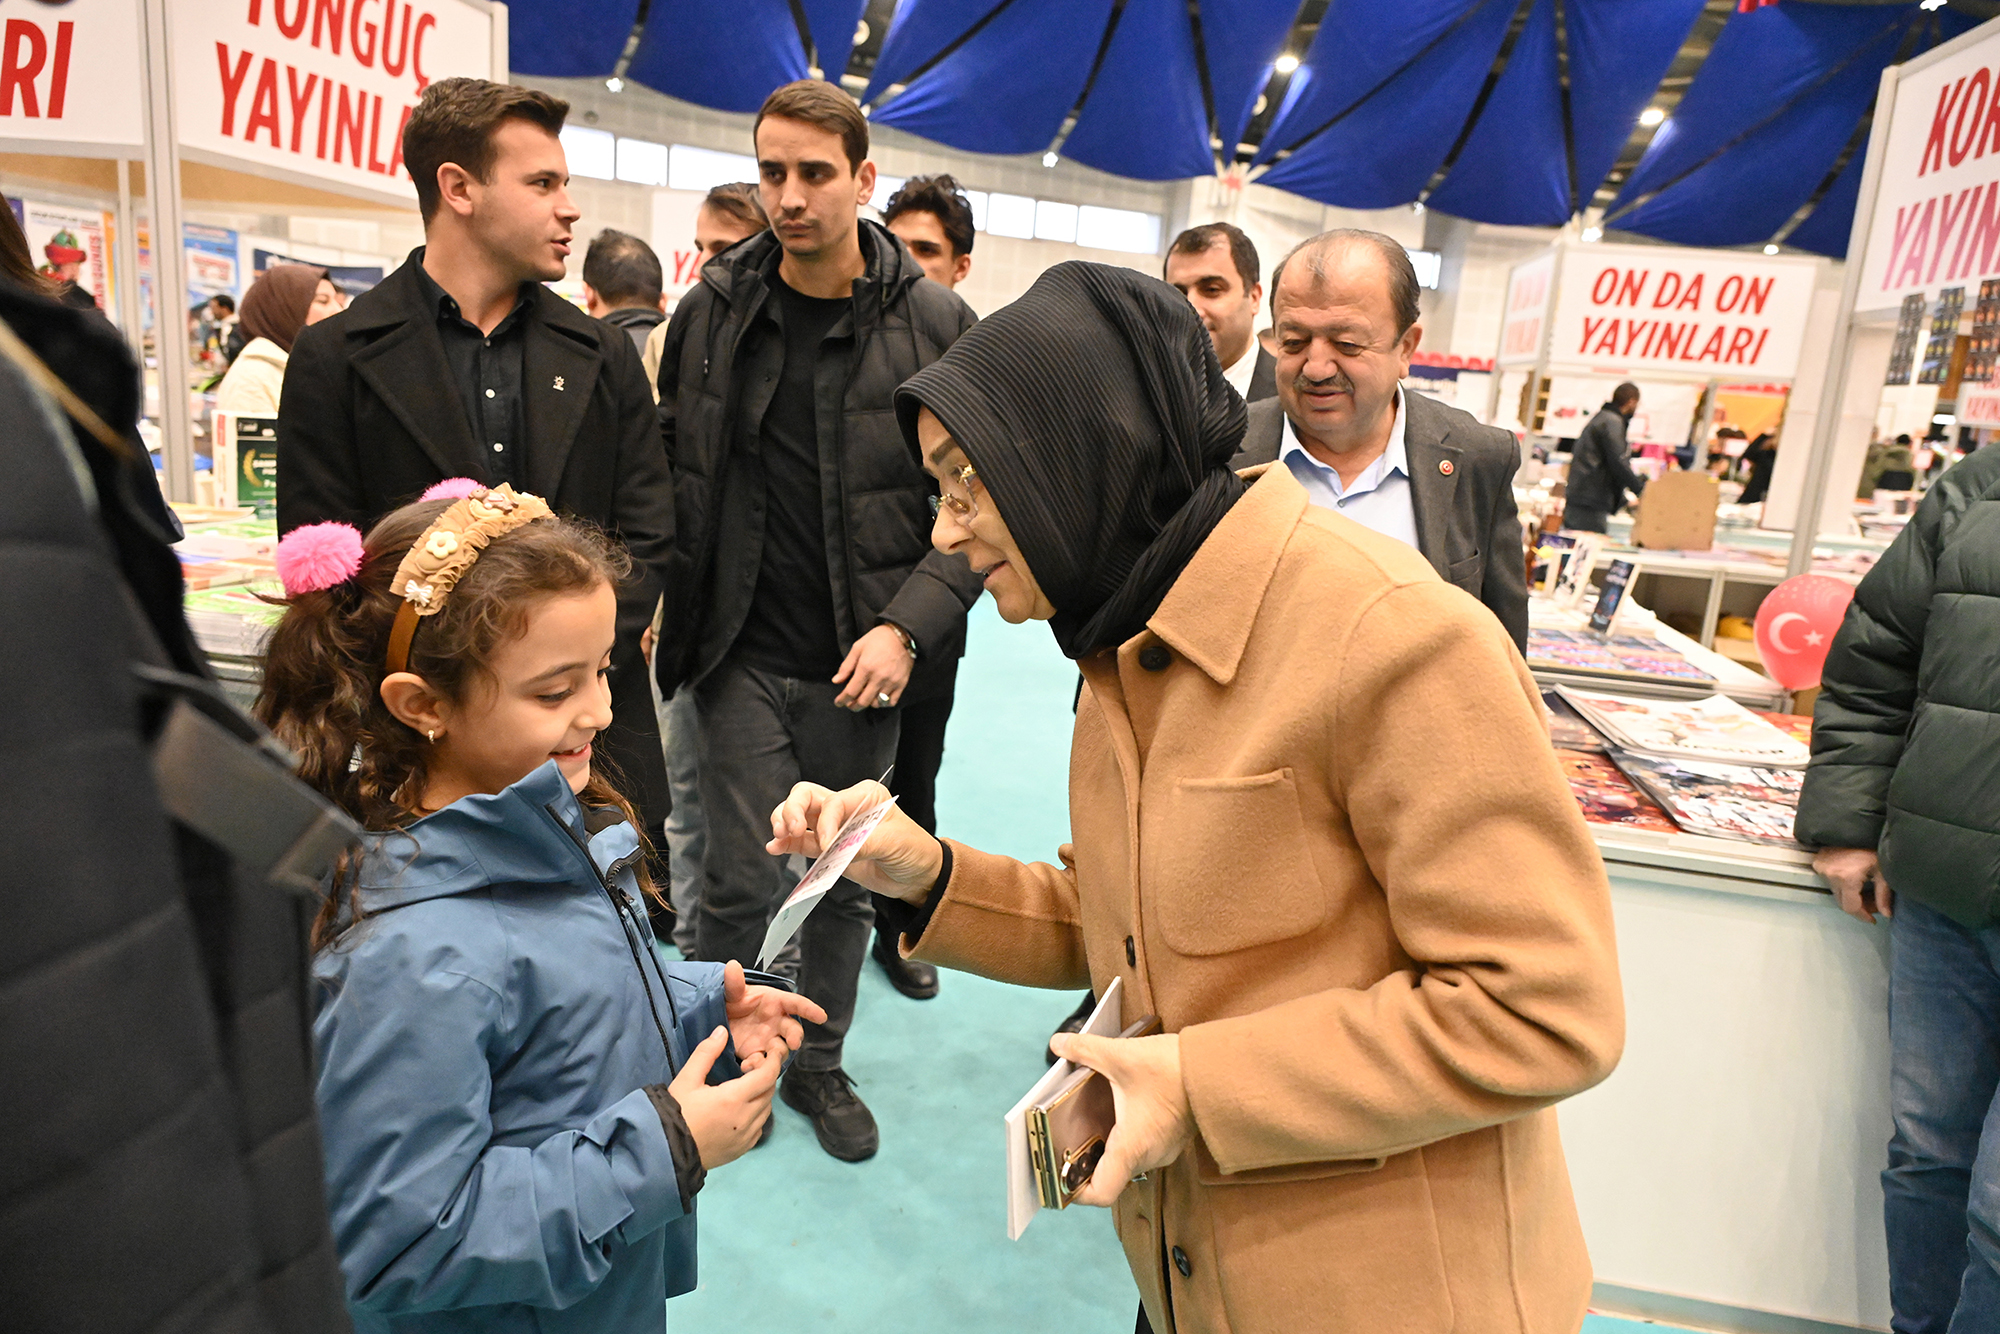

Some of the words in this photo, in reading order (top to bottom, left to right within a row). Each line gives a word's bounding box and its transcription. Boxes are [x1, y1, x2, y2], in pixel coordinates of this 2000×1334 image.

[248, 0, 434, 97] NGUÇ
[1881, 181, 2000, 291] YAYIN
[1591, 267, 1649, 307] ON
[1652, 271, 1705, 312] DA
[1715, 275, 1776, 316] ON
[1578, 316, 1770, 366] YAYINLARI
